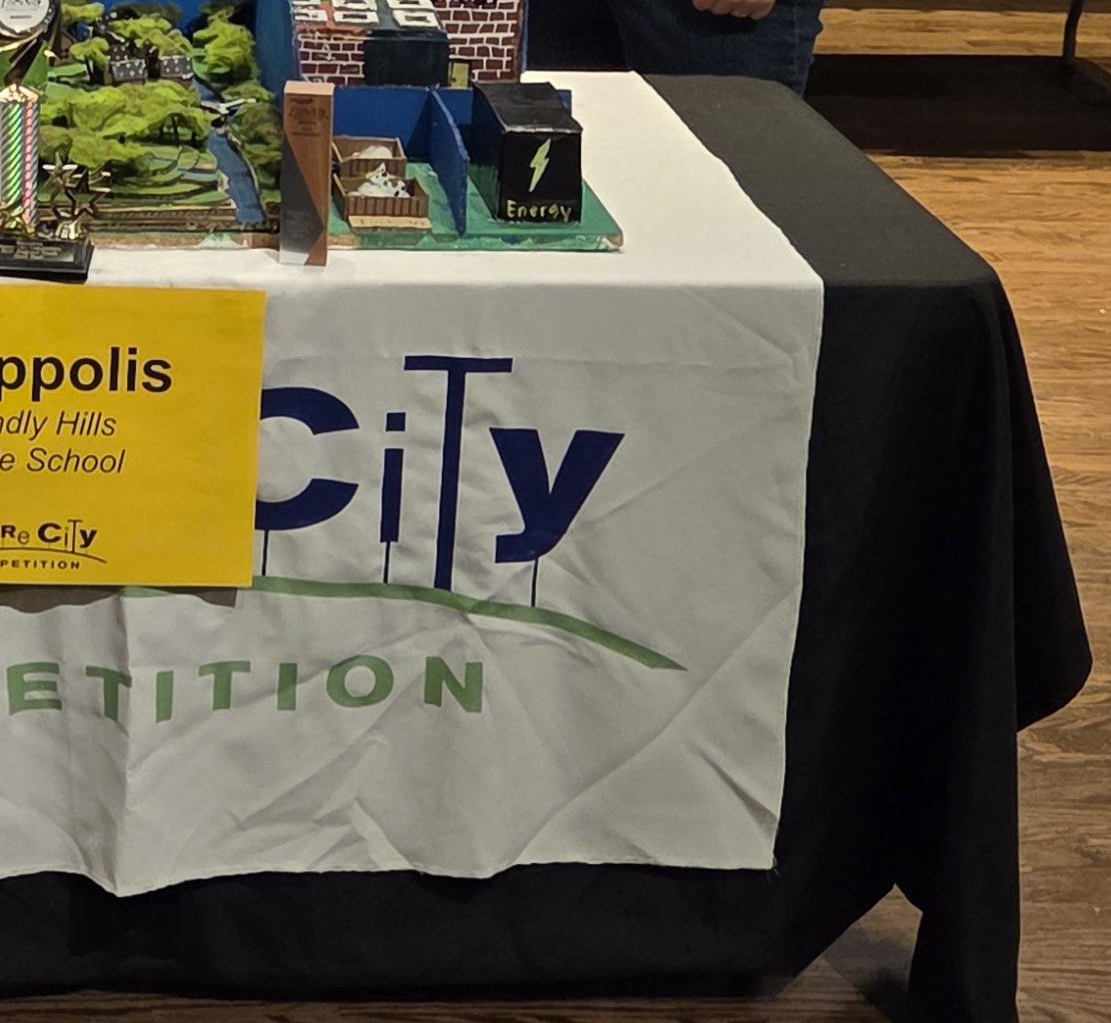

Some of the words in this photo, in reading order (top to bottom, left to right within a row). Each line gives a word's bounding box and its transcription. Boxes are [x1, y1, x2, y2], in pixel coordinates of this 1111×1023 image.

[505, 199, 572, 221] Energy
[56, 411, 117, 437] Hills
[27, 448, 126, 474] School
